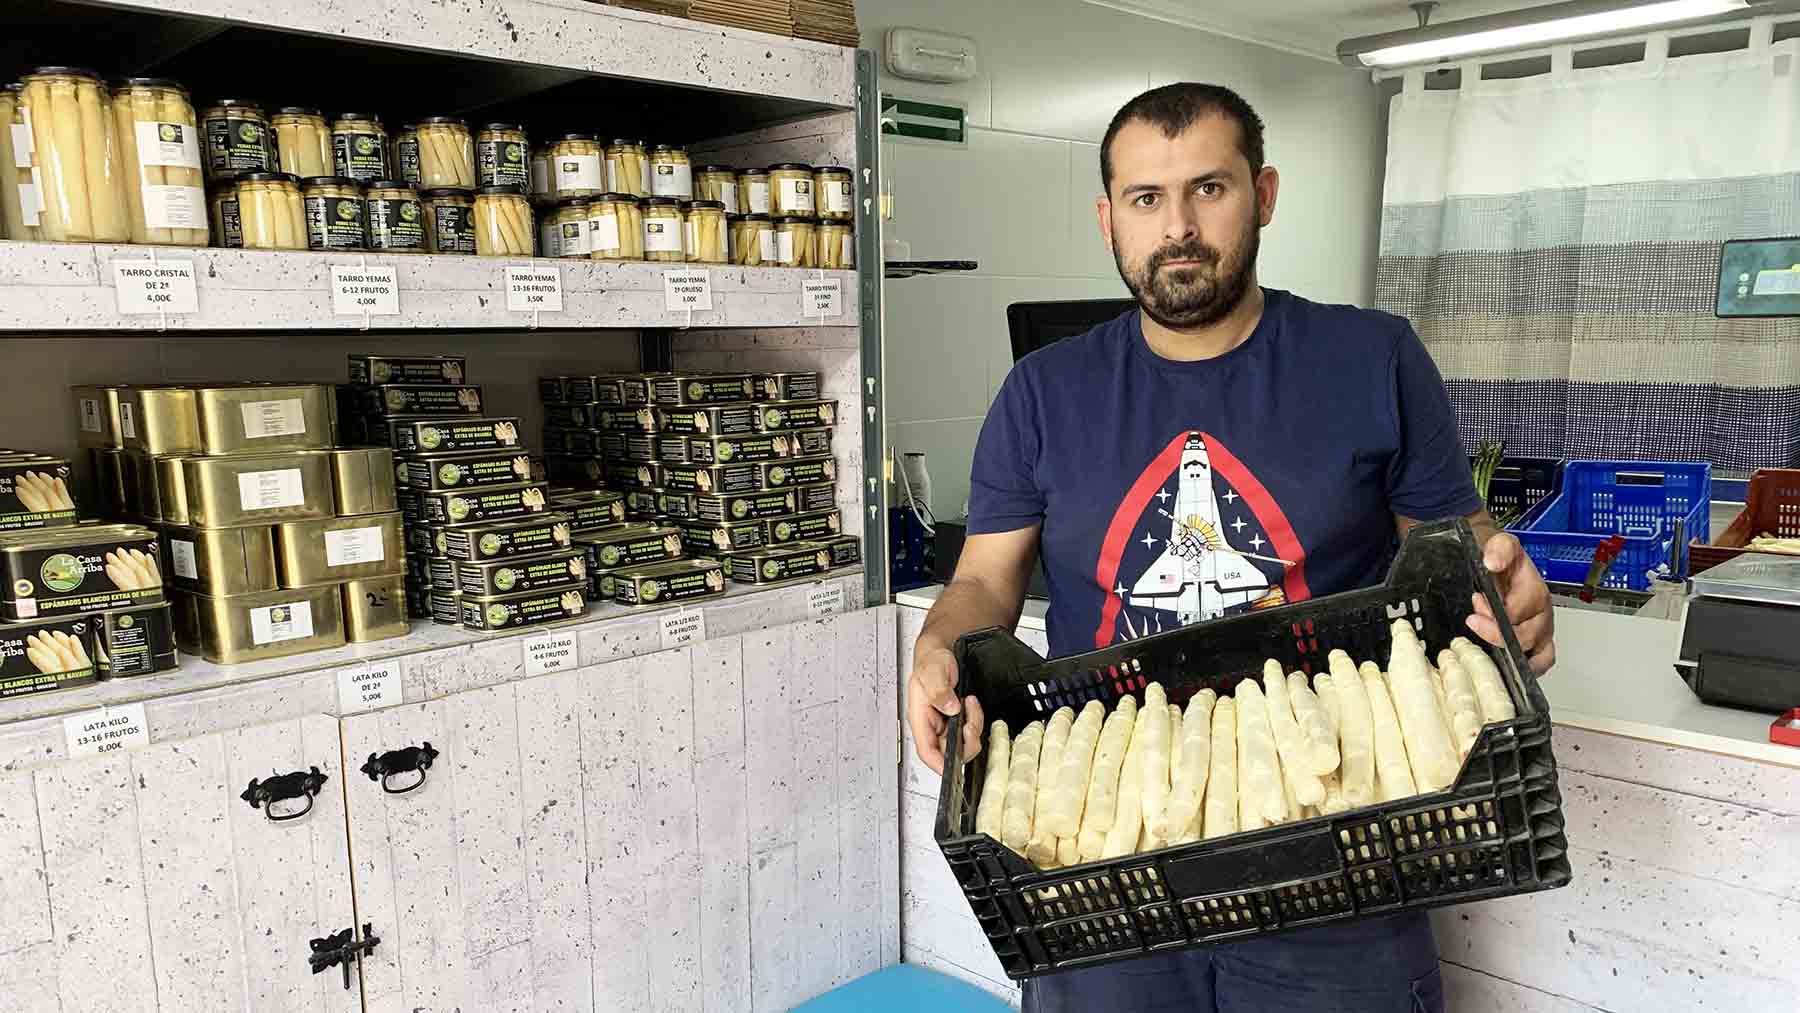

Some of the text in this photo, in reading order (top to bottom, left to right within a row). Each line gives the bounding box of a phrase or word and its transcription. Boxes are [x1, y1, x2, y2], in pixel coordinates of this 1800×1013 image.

[120, 269, 190, 278] TARRO CRISTAL
[366, 275, 391, 283] YEMAS
[342, 286, 389, 294] 6-12 FRUTOS
[147, 294, 172, 302] 4,00€
[0, 515, 22, 523] LANCOS
[76, 555, 102, 564] Casa
[70, 564, 103, 575] Arriba
[1224, 572, 1241, 580] USA
[82, 594, 110, 604] BLANCOS
[111, 592, 131, 601] EXTRA
[665, 620, 678, 628] LATA
[678, 625, 698, 633] FRUTOS
[1, 648, 24, 657] riba
[545, 650, 569, 658] FRUTOS
[352, 670, 388, 682] LATA KILO
[4, 678, 34, 689] BLANCOS
[35, 675, 57, 684] EXTRA
[361, 683, 371, 691] DE
[362, 693, 382, 702] 5,00€
[83, 716, 129, 732] LATA KILO
[77, 726, 140, 745] 13-16 FRUTOS
[98, 741, 122, 753] 8,00€
